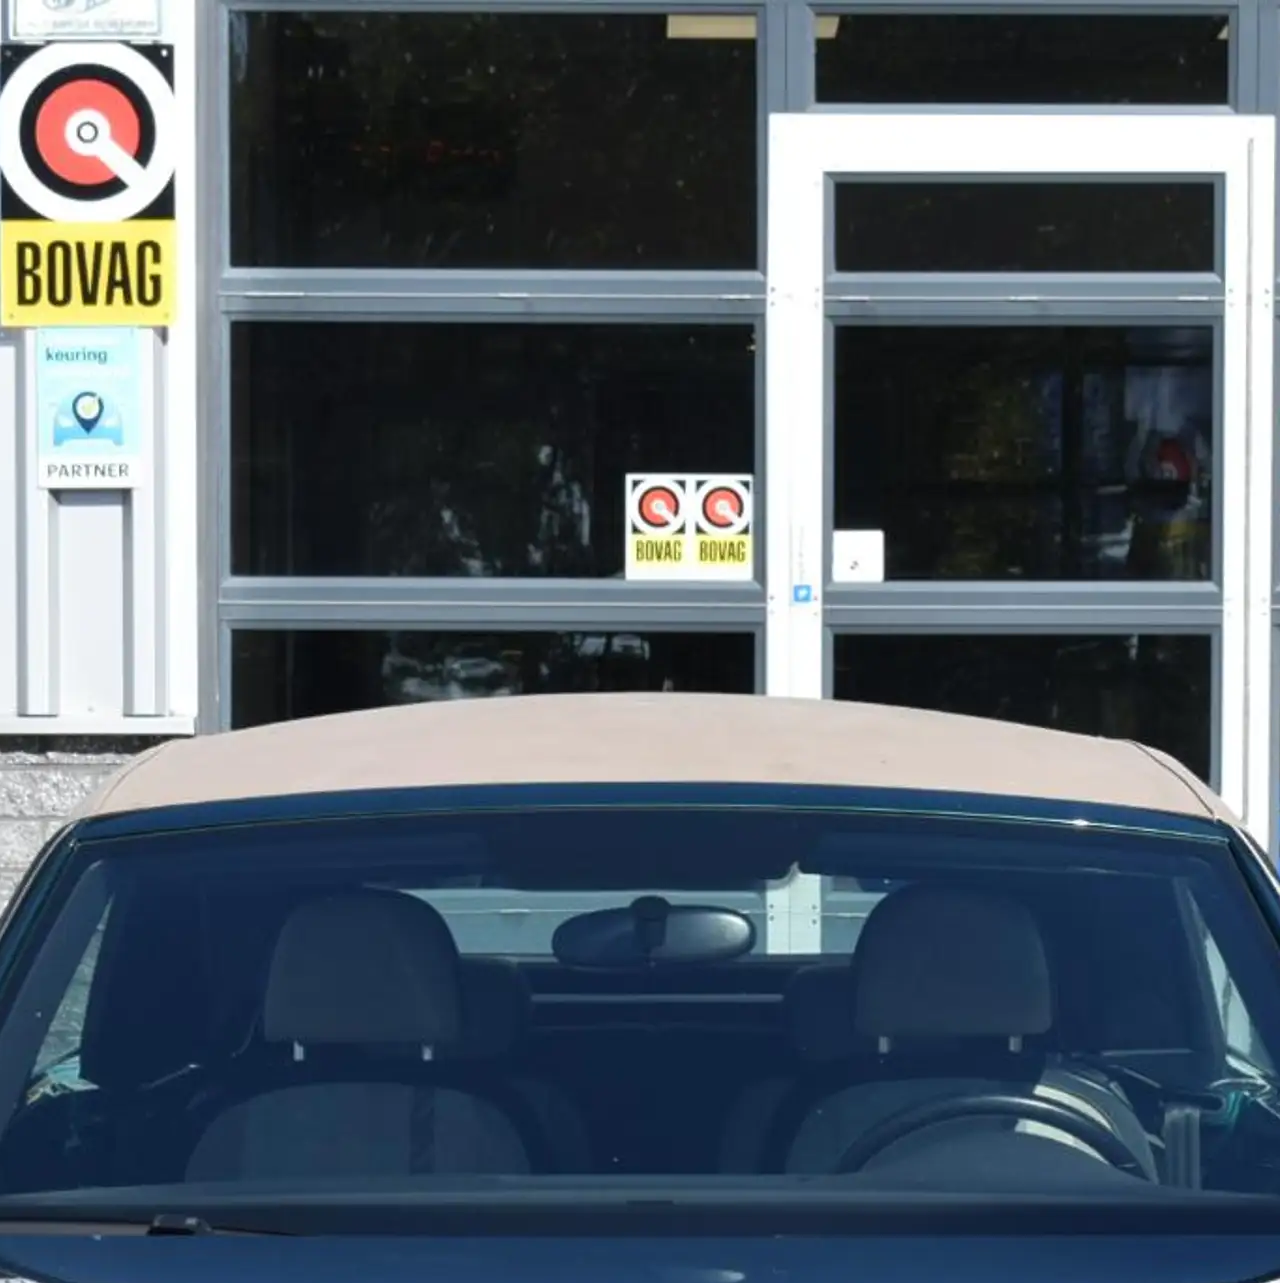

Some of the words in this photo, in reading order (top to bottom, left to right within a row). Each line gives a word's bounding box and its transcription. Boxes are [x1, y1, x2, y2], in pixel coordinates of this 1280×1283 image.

[16, 240, 162, 307] BOVAG
[46, 347, 108, 365] keuring
[47, 463, 130, 478] PARTNER
[636, 540, 682, 563] BOVAG
[699, 540, 746, 563] BOVAG
